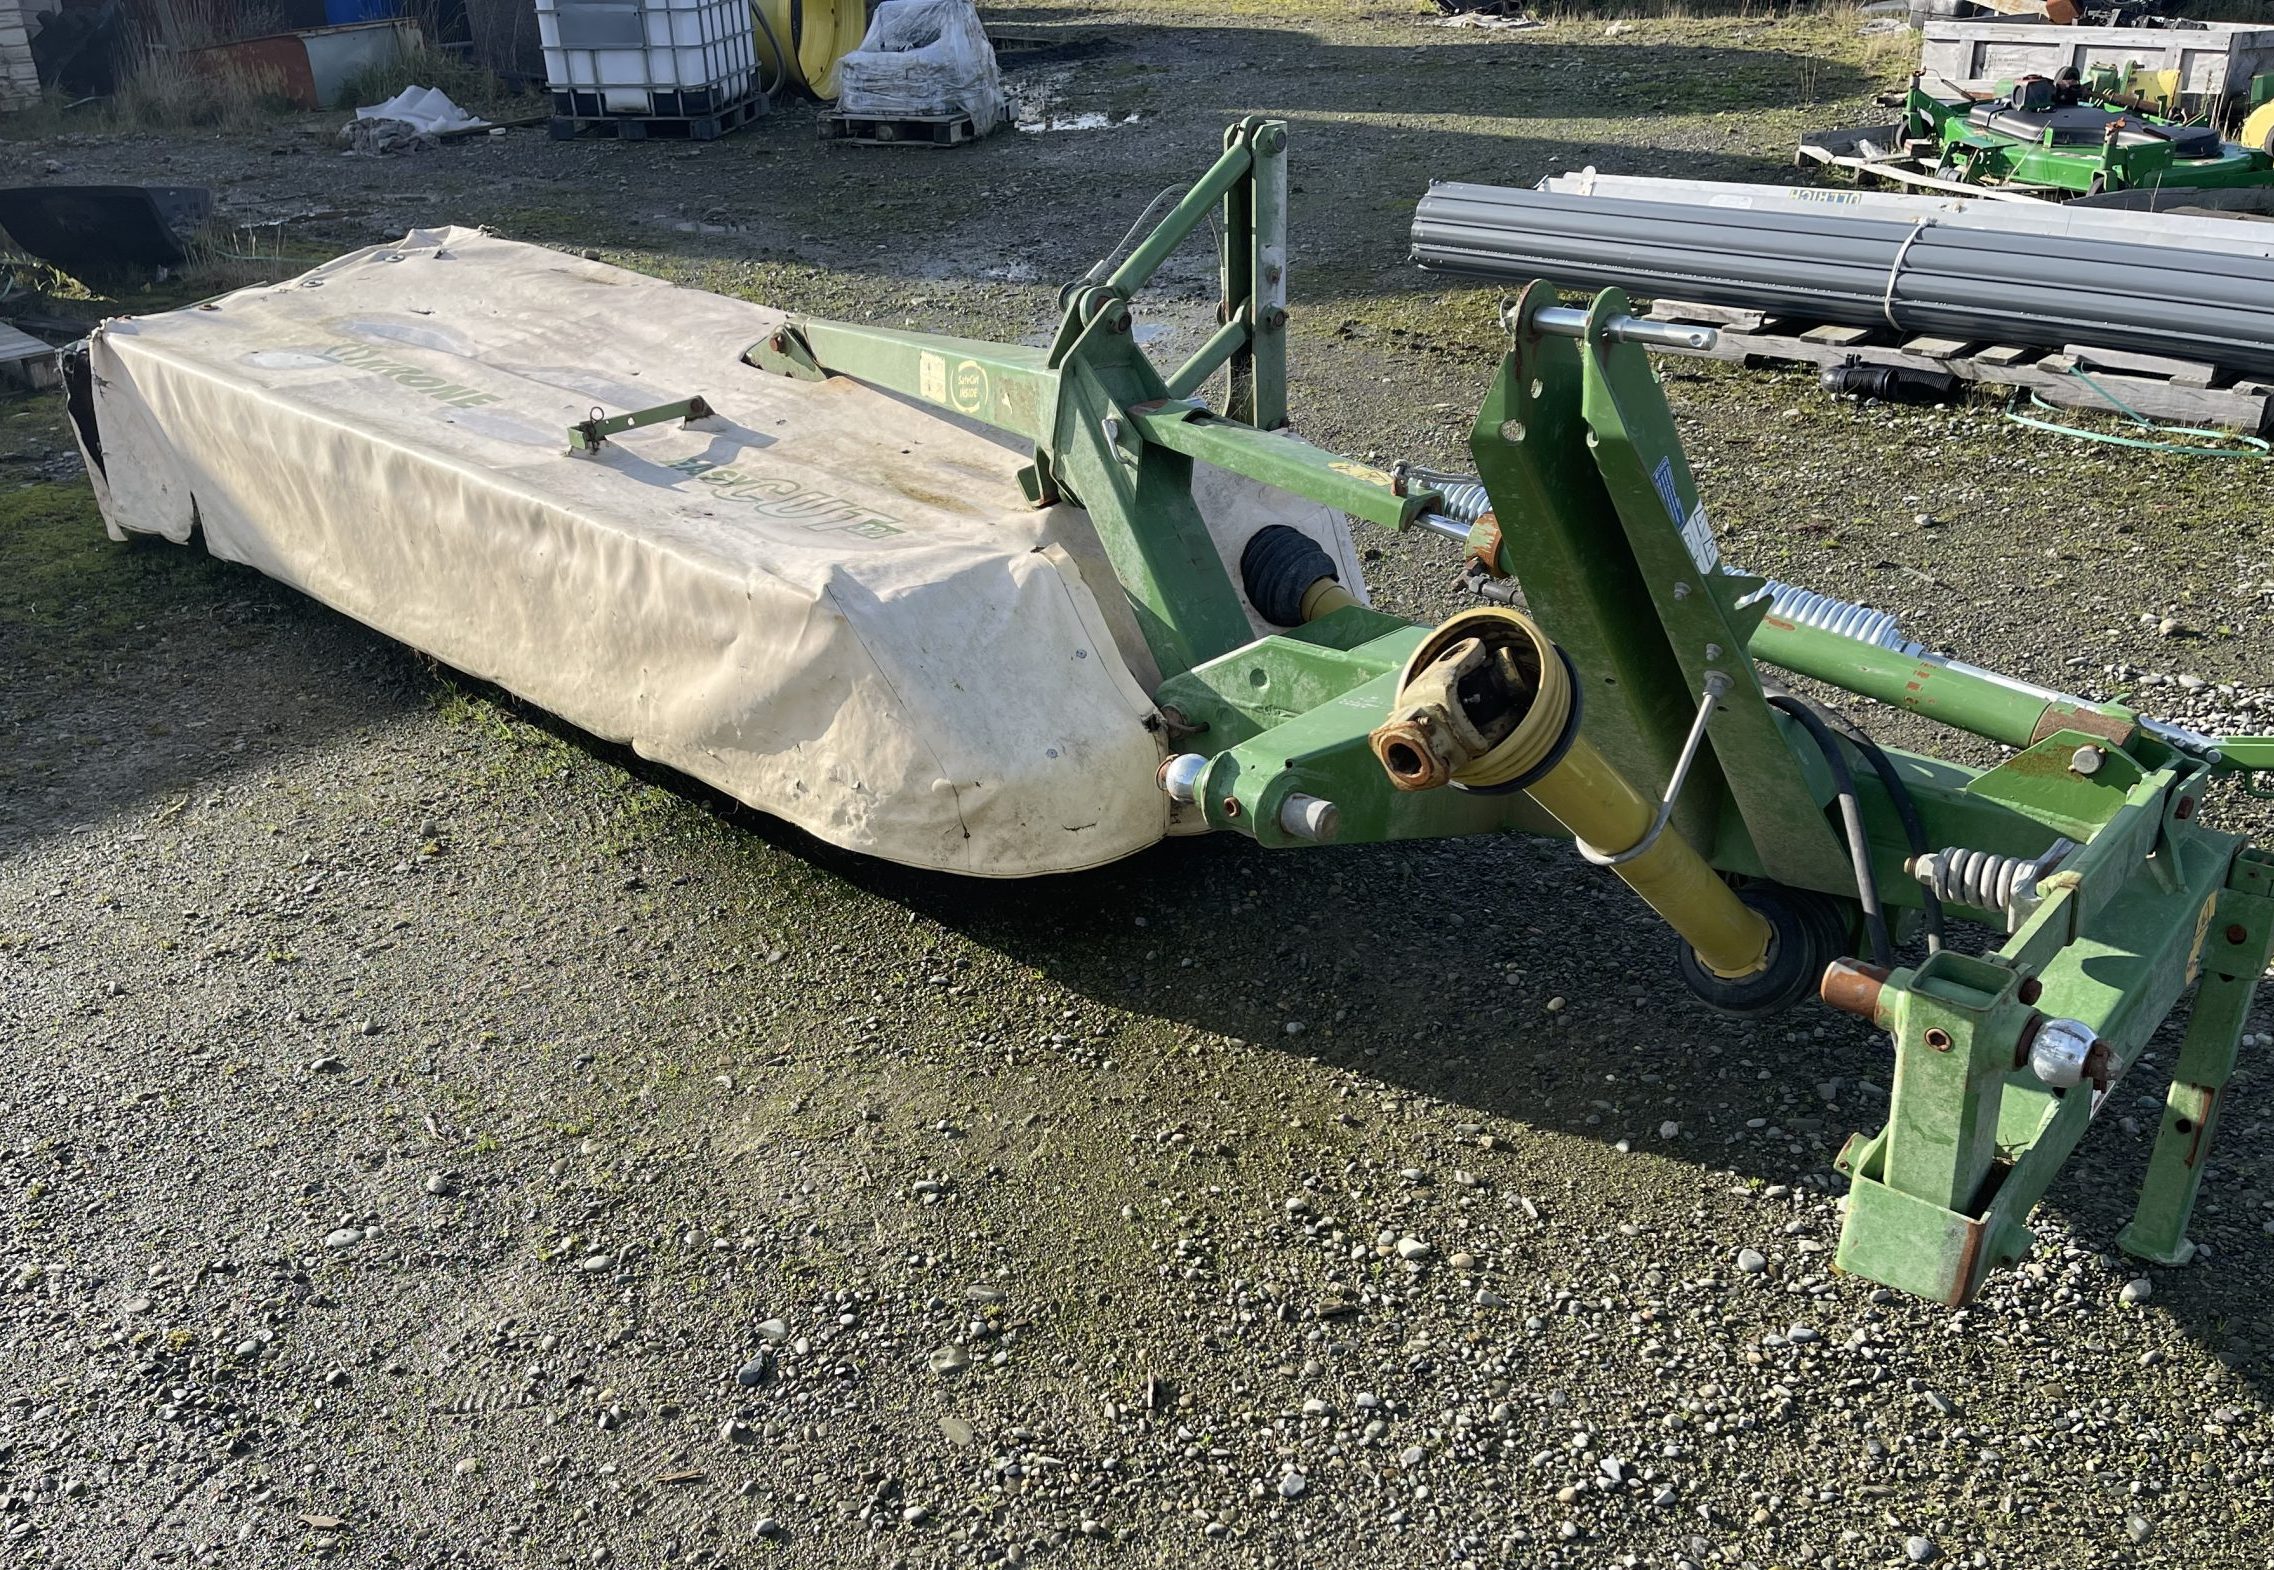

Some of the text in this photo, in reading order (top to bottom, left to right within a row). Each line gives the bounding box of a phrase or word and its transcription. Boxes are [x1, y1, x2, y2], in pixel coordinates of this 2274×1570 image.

[1790, 190, 1861, 205] ULLRICH
[343, 358, 504, 408] KRONE
[959, 388, 979, 398] INSIDE
